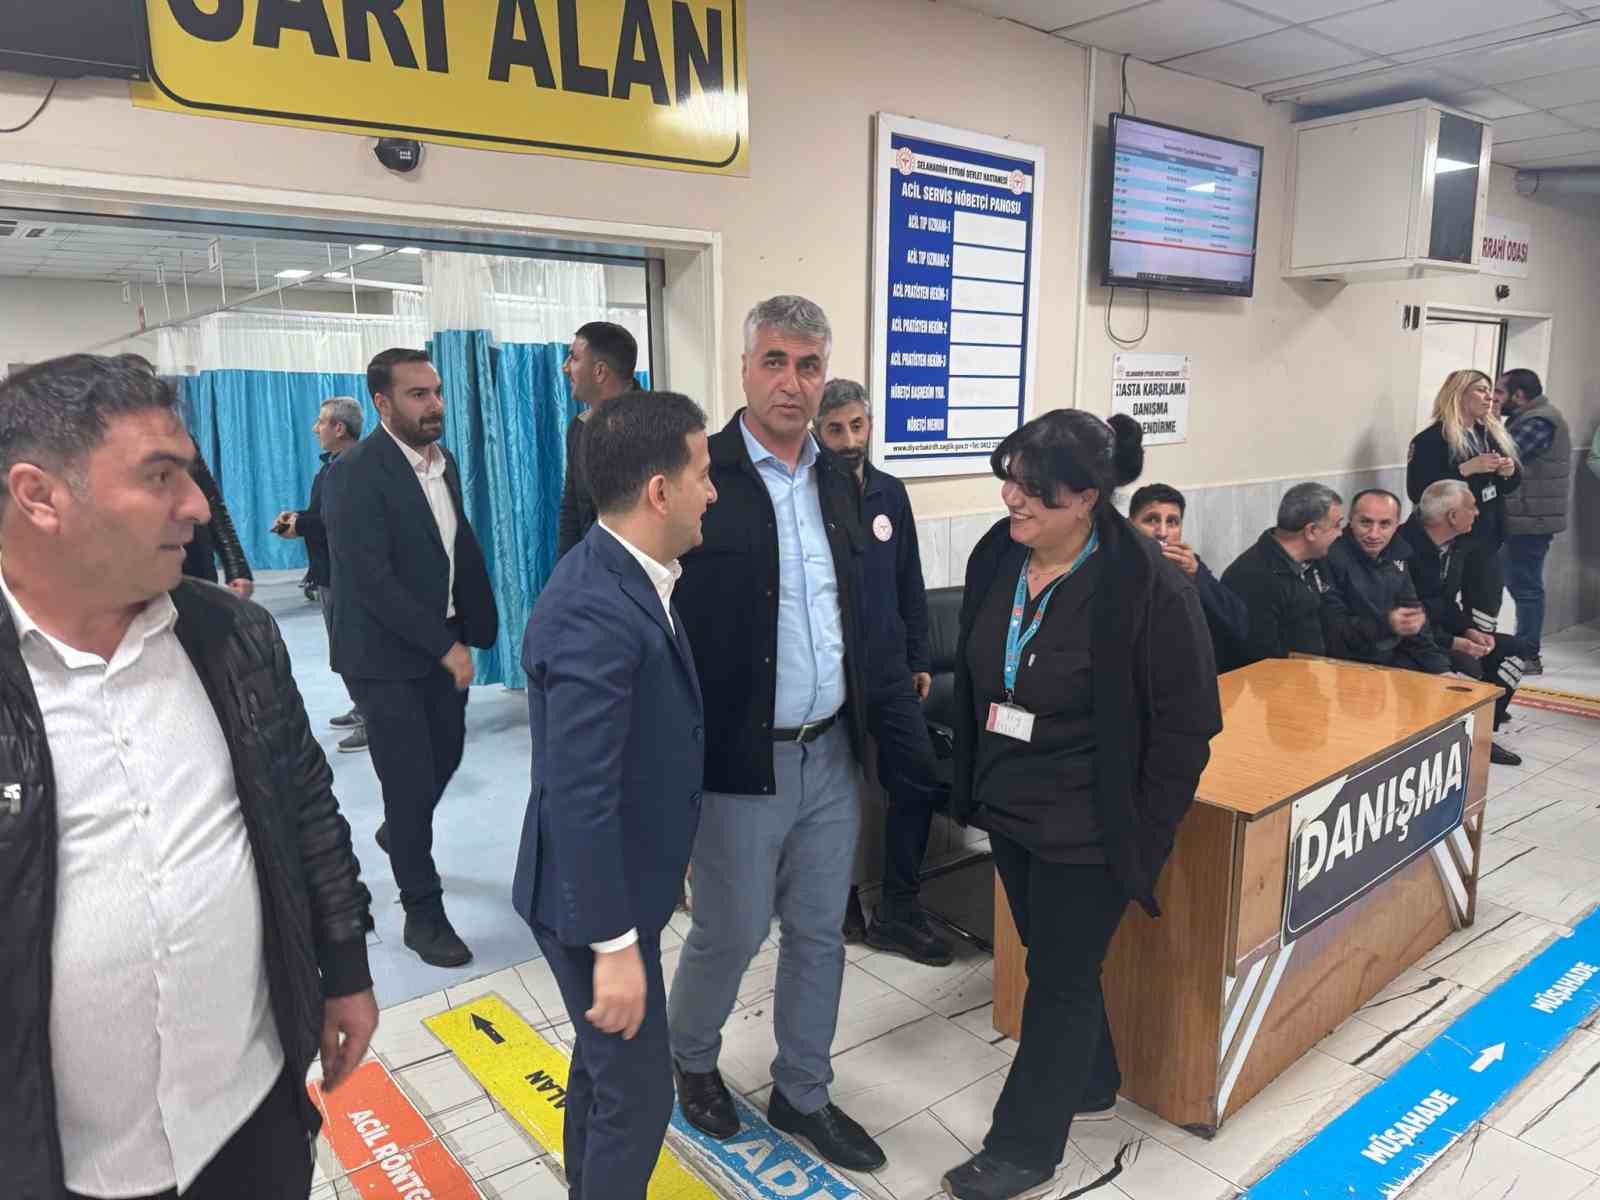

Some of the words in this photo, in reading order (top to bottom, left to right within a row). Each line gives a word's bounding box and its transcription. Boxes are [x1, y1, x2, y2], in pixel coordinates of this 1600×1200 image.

[488, 0, 723, 110] ALAN
[902, 181, 921, 198] ACİL
[923, 185, 952, 204] SERVİS
[954, 189, 988, 211] NÖBETÇİ
[990, 197, 1021, 214] PANOSU
[908, 213, 919, 229] ACİL
[920, 216, 928, 229] TIP
[907, 248, 918, 264] ACİL
[918, 251, 926, 265] TIP
[1482, 235, 1506, 260] RRAHİ
[1507, 240, 1529, 263] ODASI
[893, 281, 904, 298] ACİL
[892, 315, 903, 332] ACİL
[891, 350, 902, 366] ACİL
[891, 383, 911, 400] NÖBETÇİ
[1143, 382, 1186, 397] KARŞILAMA
[1133, 402, 1168, 416] DANIŞMA
[906, 416, 926, 432] NÖBETÇİ
[1142, 418, 1176, 434] ENDİRME
[1298, 742, 1463, 891] DANIŞMA
[1530, 960, 1600, 1014] MÜŞAHADE
[346, 1108, 391, 1148] ACİL
[1360, 1087, 1459, 1166] MÜŞAHADE
